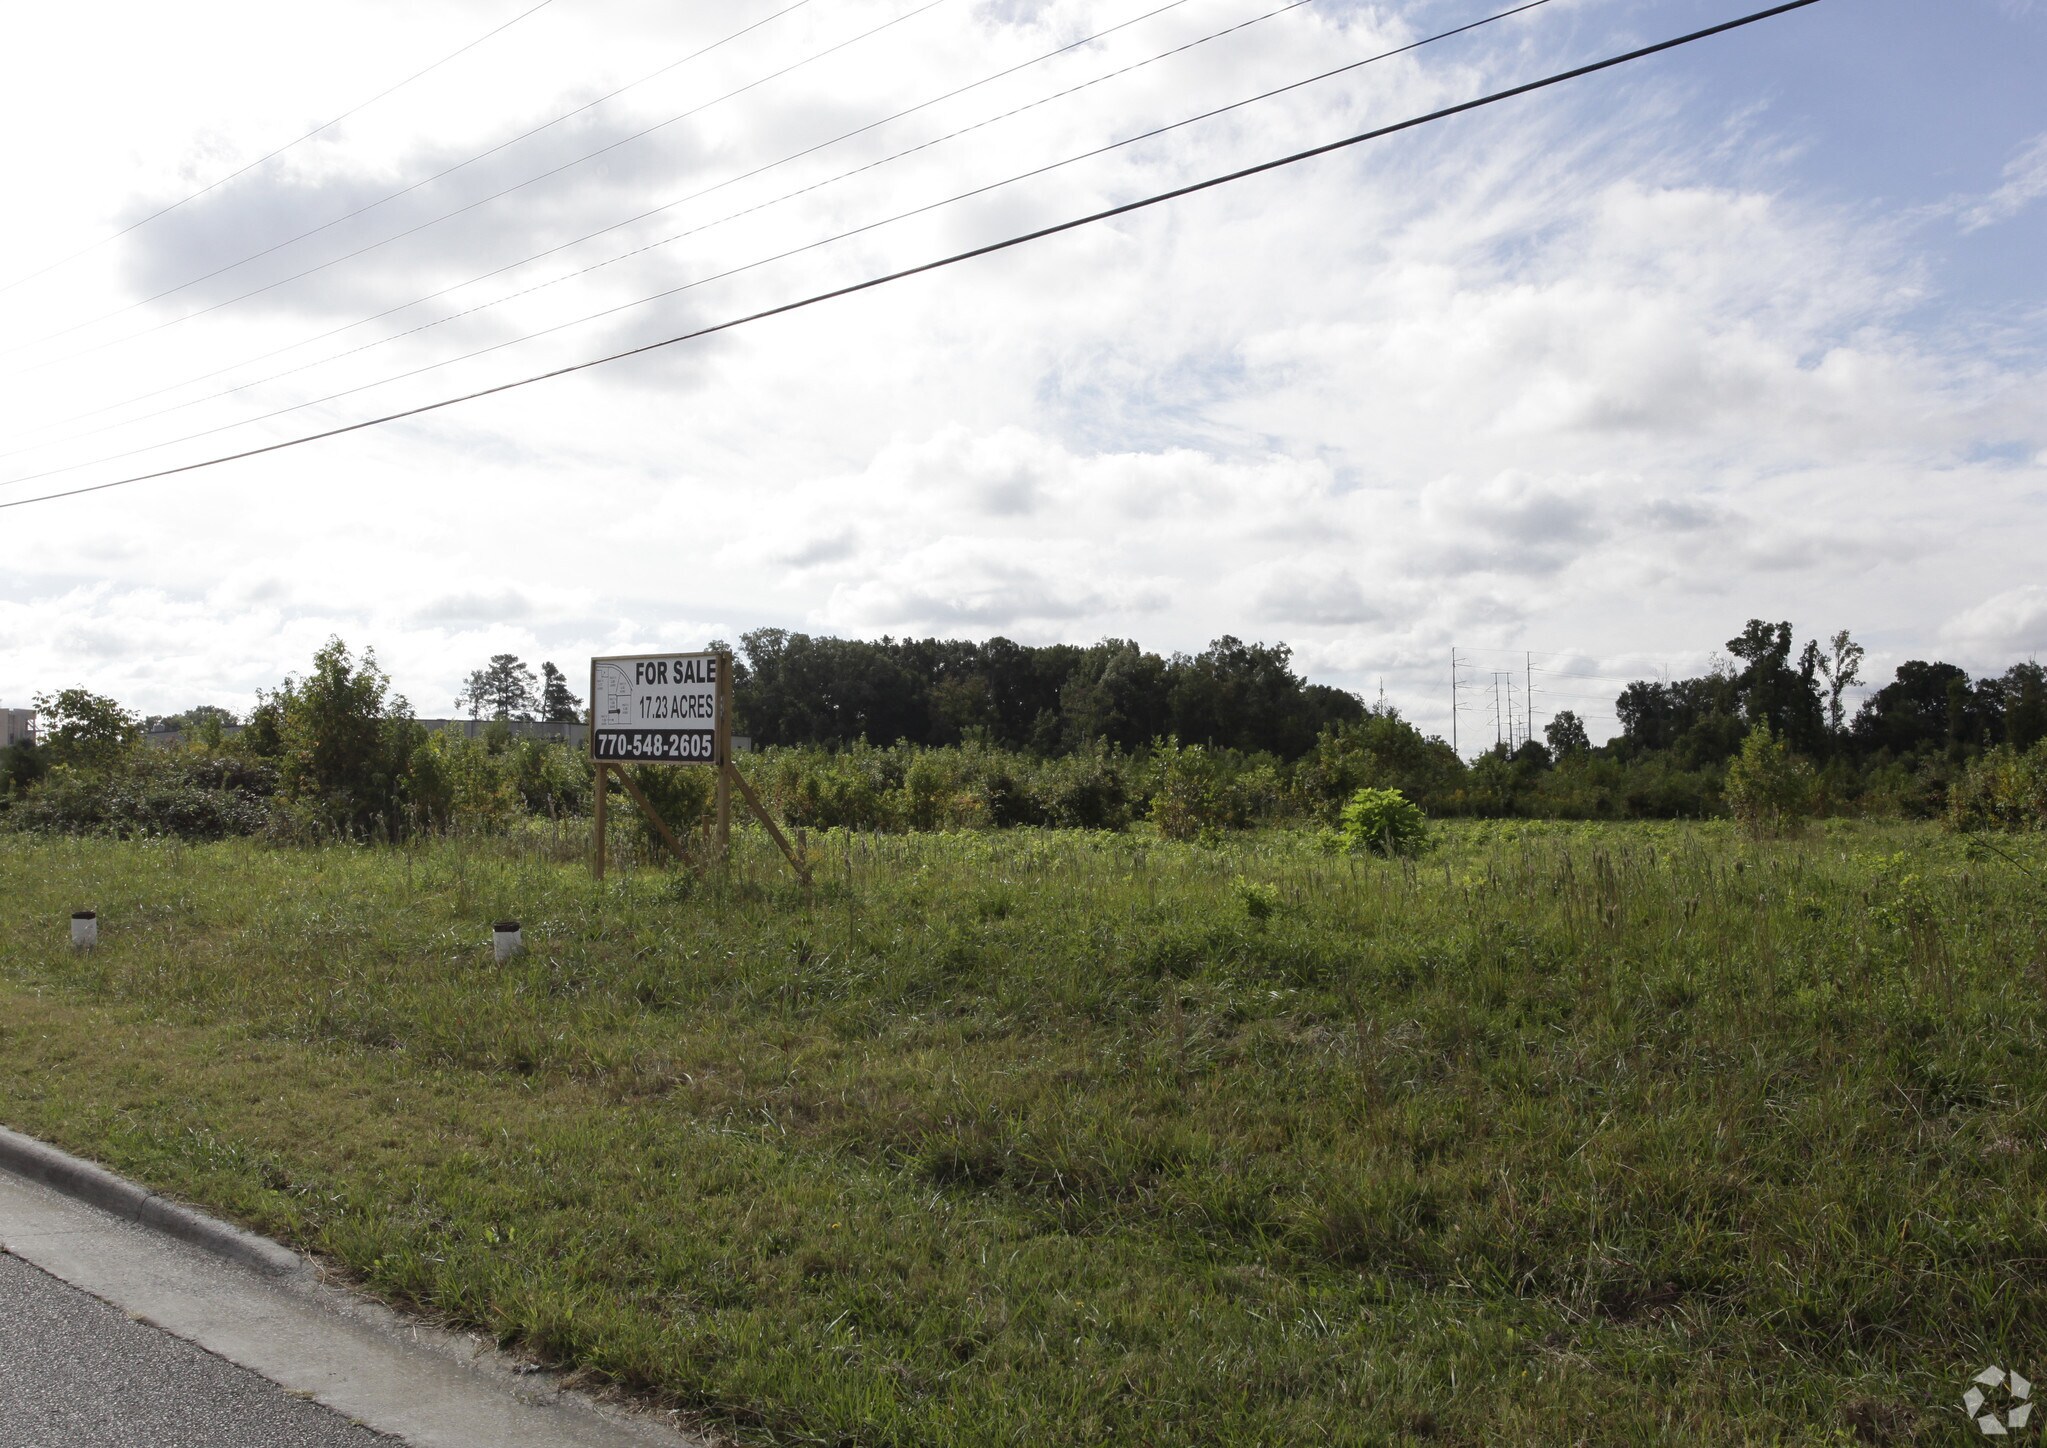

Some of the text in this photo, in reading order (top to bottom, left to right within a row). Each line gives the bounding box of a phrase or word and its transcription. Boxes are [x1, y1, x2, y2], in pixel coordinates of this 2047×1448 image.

[636, 661, 668, 685] FOR
[673, 659, 717, 684] SALE
[640, 695, 668, 719] 17.23
[671, 694, 713, 719] ACRES
[598, 734, 712, 757] 770-548-2605
